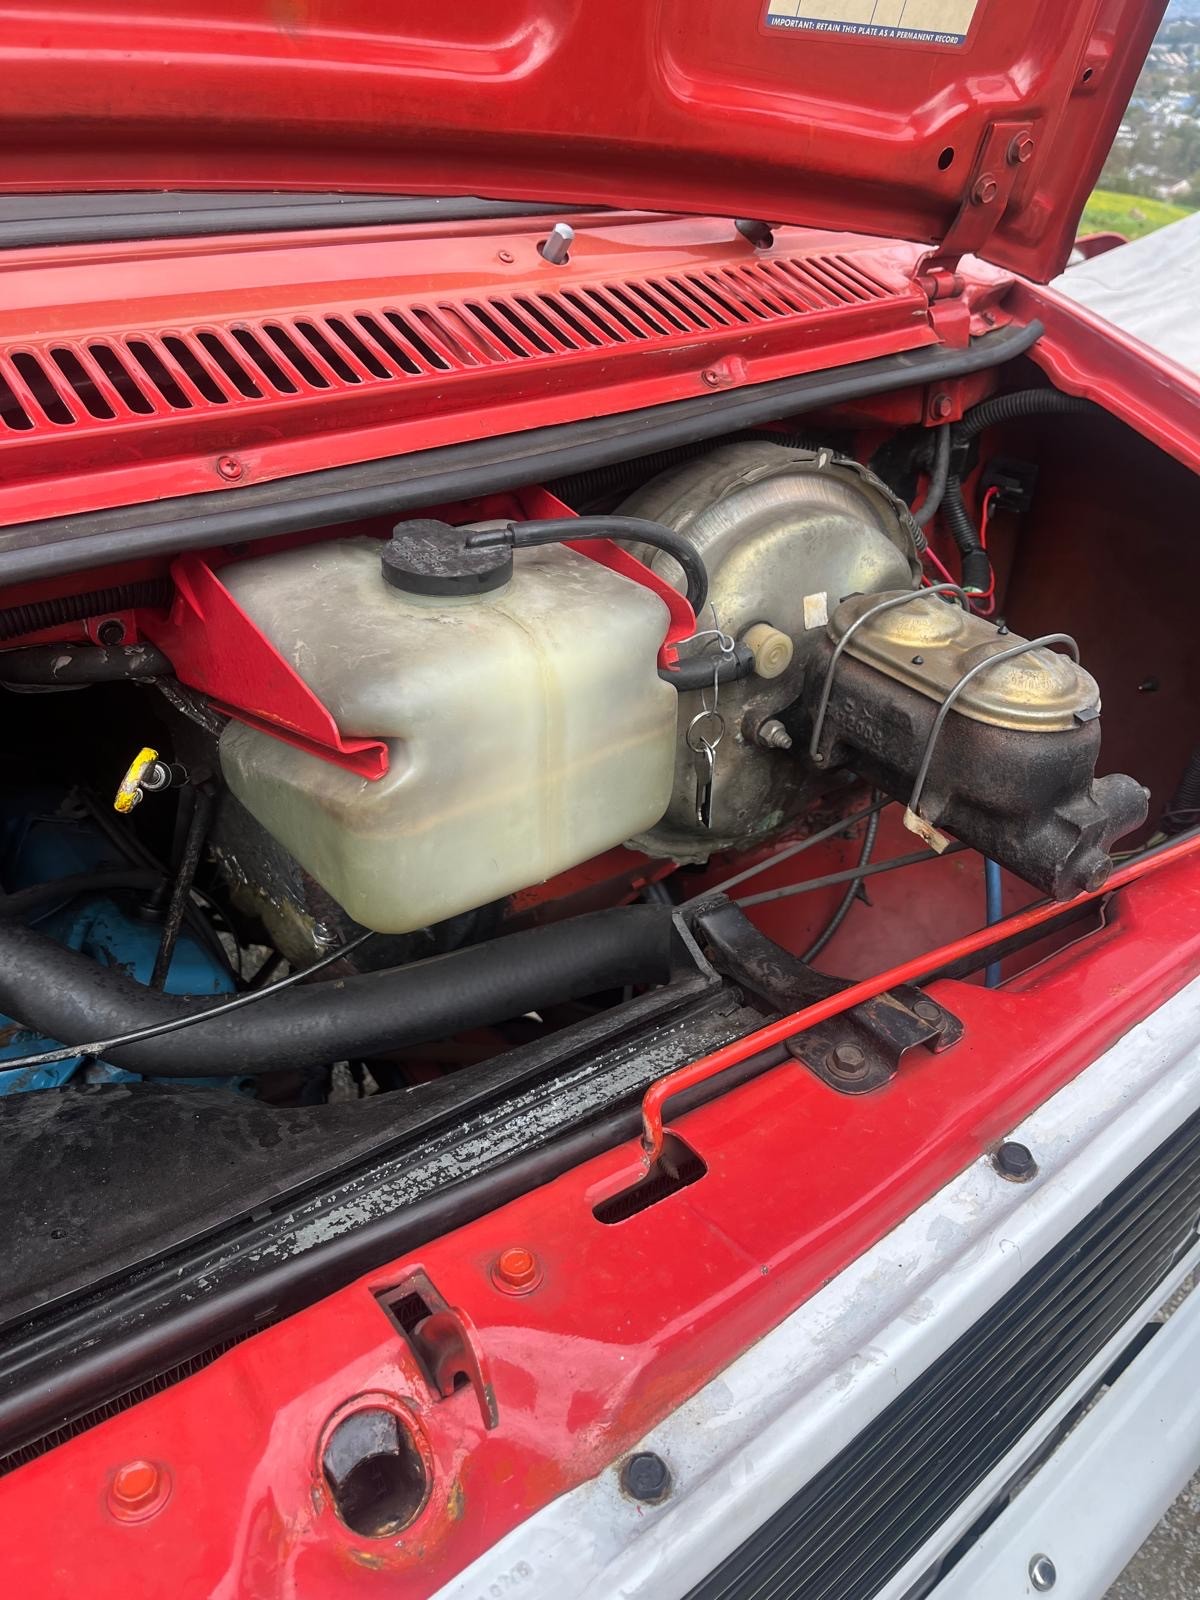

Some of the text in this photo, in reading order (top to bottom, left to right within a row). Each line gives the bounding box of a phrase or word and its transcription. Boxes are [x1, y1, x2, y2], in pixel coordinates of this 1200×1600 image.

[771, 17, 815, 30] IMPORTANT:
[815, 22, 841, 32] RETAIN
[842, 24, 857, 34] THIS
[857, 25, 878, 36] PLATE
[878, 28, 889, 37] AS
[896, 30, 935, 41] PERMANENT
[934, 34, 959, 44] RECORD
